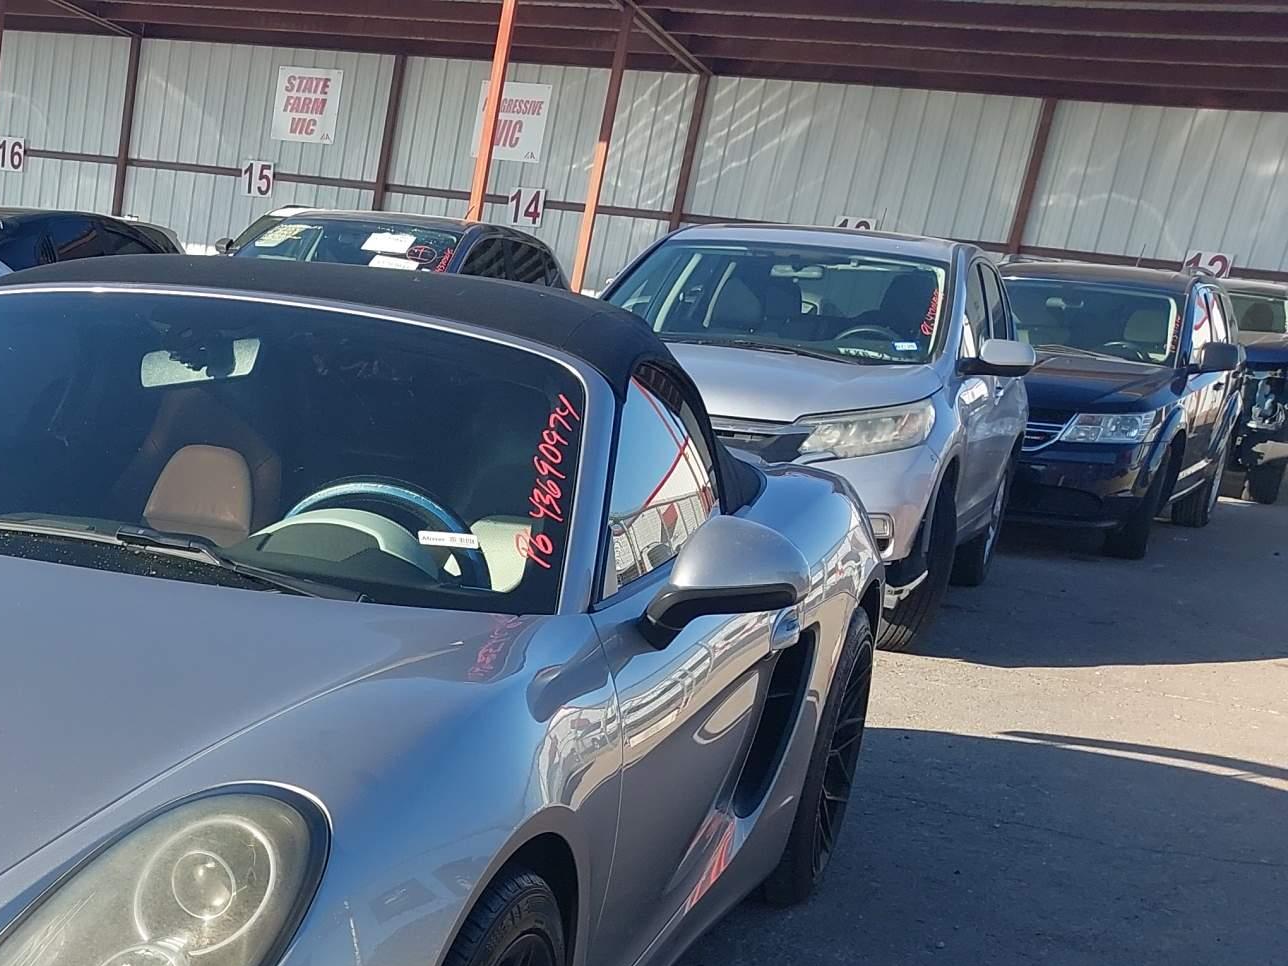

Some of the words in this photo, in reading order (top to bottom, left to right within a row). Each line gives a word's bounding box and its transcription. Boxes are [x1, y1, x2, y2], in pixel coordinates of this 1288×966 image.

[285, 75, 331, 95] STATE
[283, 96, 327, 115] FARM
[482, 97, 544, 116] GRESSIVE
[289, 117, 317, 136] VIC
[244, 163, 272, 195] 15
[510, 189, 541, 225] 14
